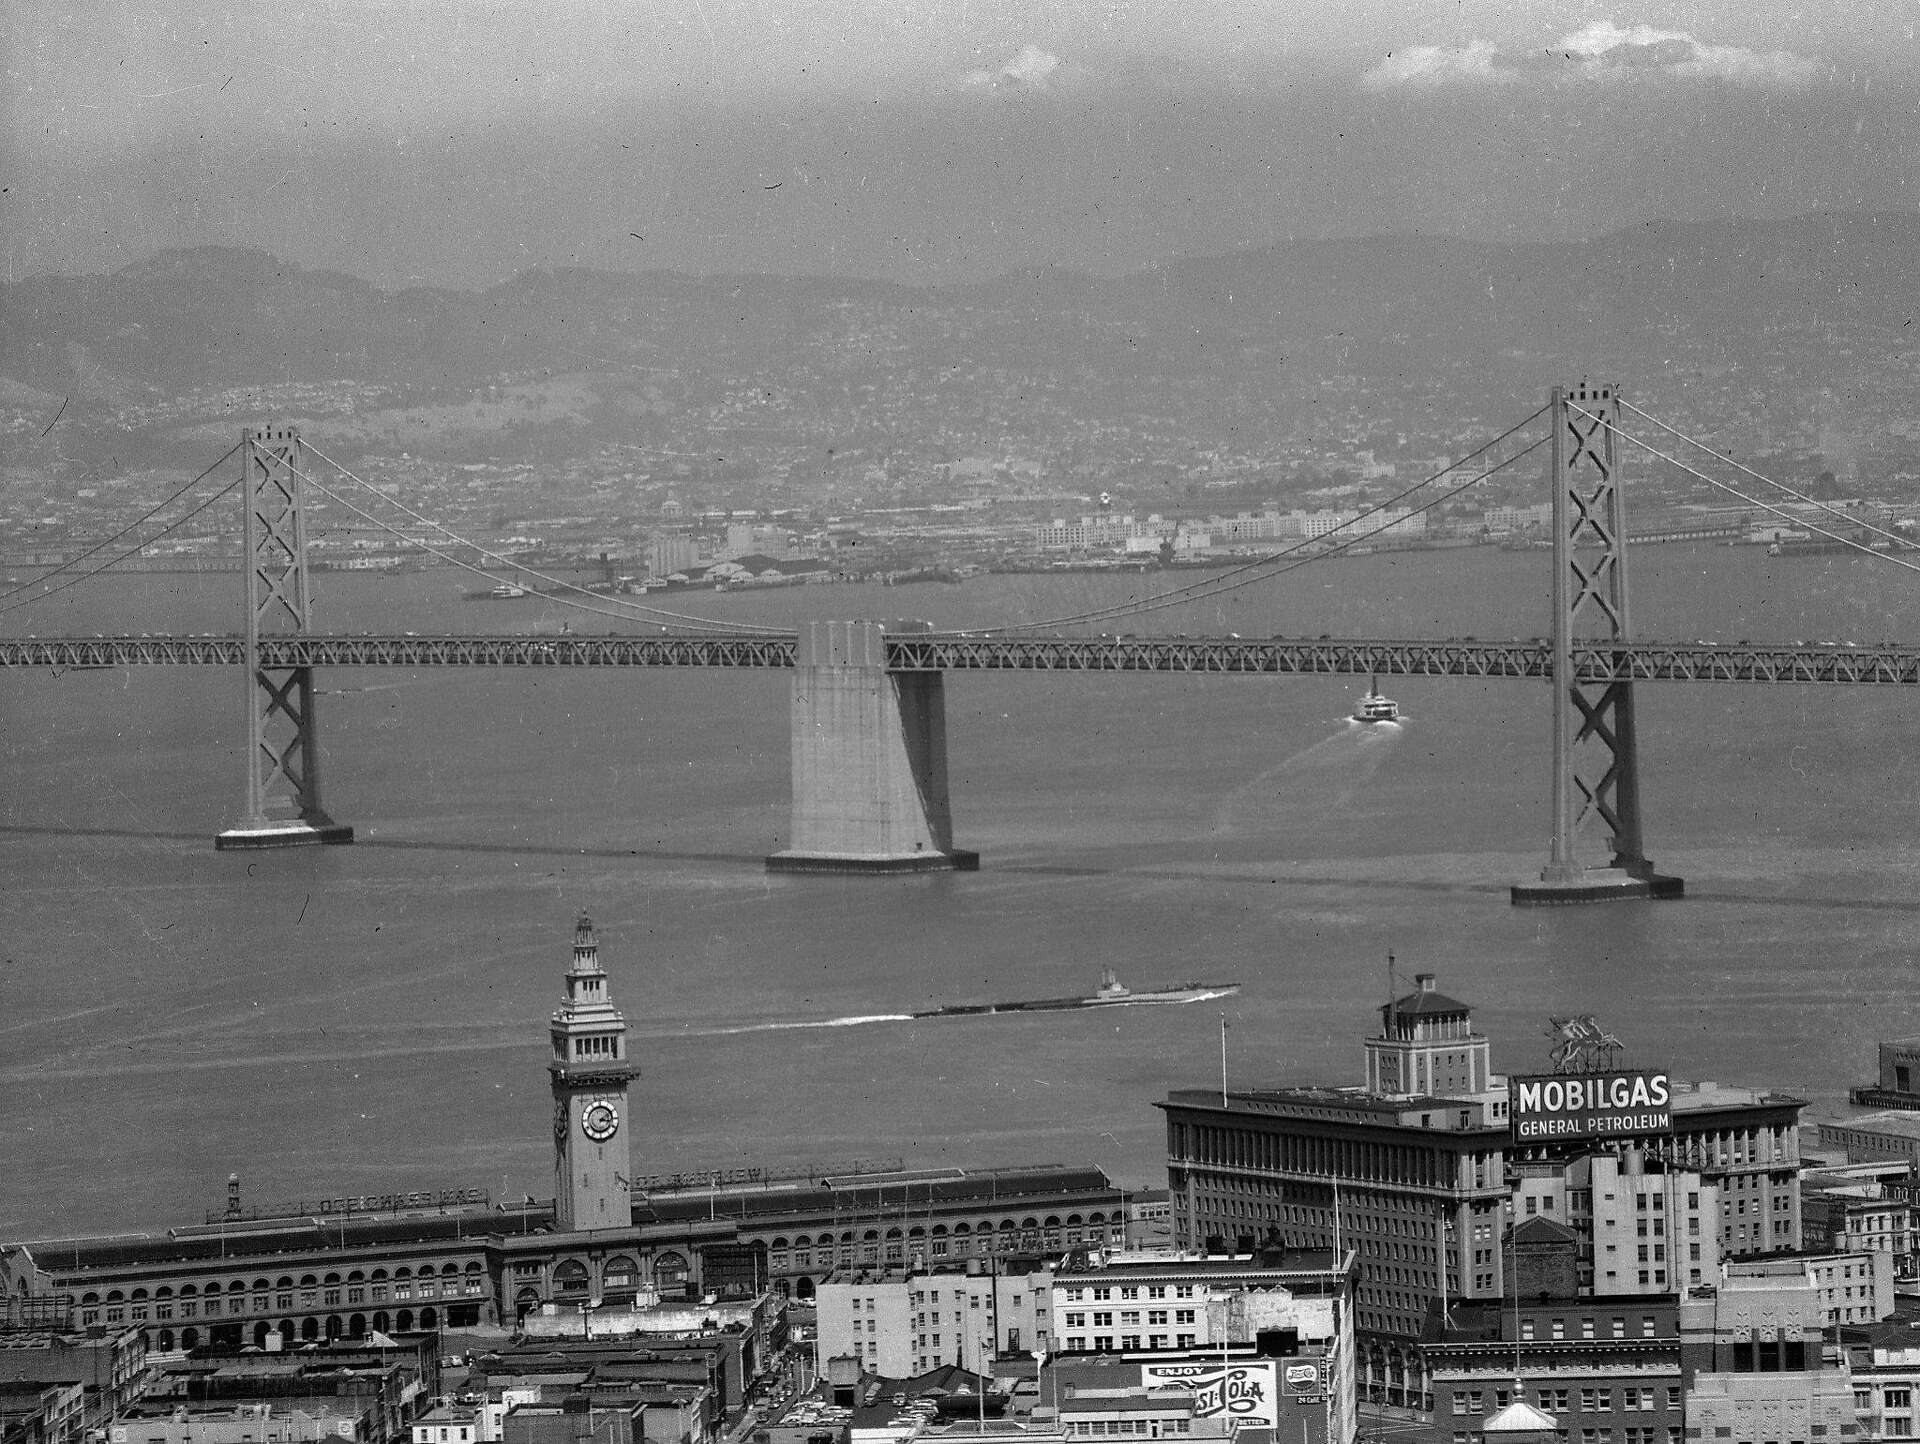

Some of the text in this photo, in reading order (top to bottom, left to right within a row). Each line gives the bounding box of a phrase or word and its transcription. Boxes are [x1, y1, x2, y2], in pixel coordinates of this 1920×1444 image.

[1519, 1075, 1669, 1114] MOBILGAS
[1520, 1113, 1669, 1136] GENERAL PETROLEUM
[1156, 1367, 1204, 1376] ENJOY
